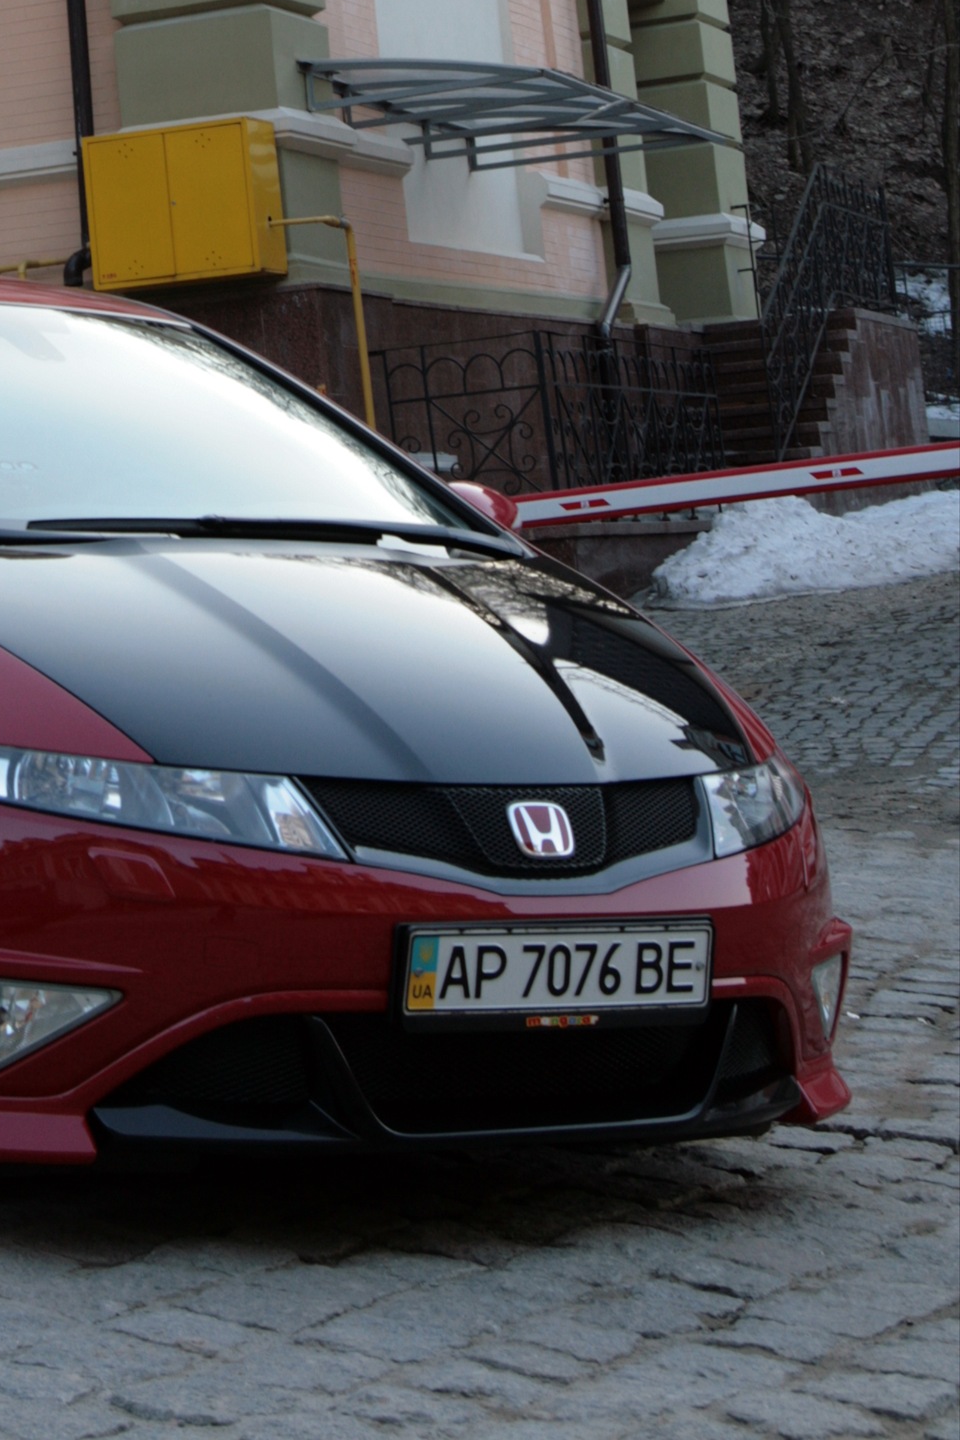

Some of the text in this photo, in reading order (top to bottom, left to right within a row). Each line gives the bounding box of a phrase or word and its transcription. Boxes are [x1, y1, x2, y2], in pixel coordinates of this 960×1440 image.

[439, 941, 695, 999] AP 7076 BE
[412, 985, 433, 999] UA
